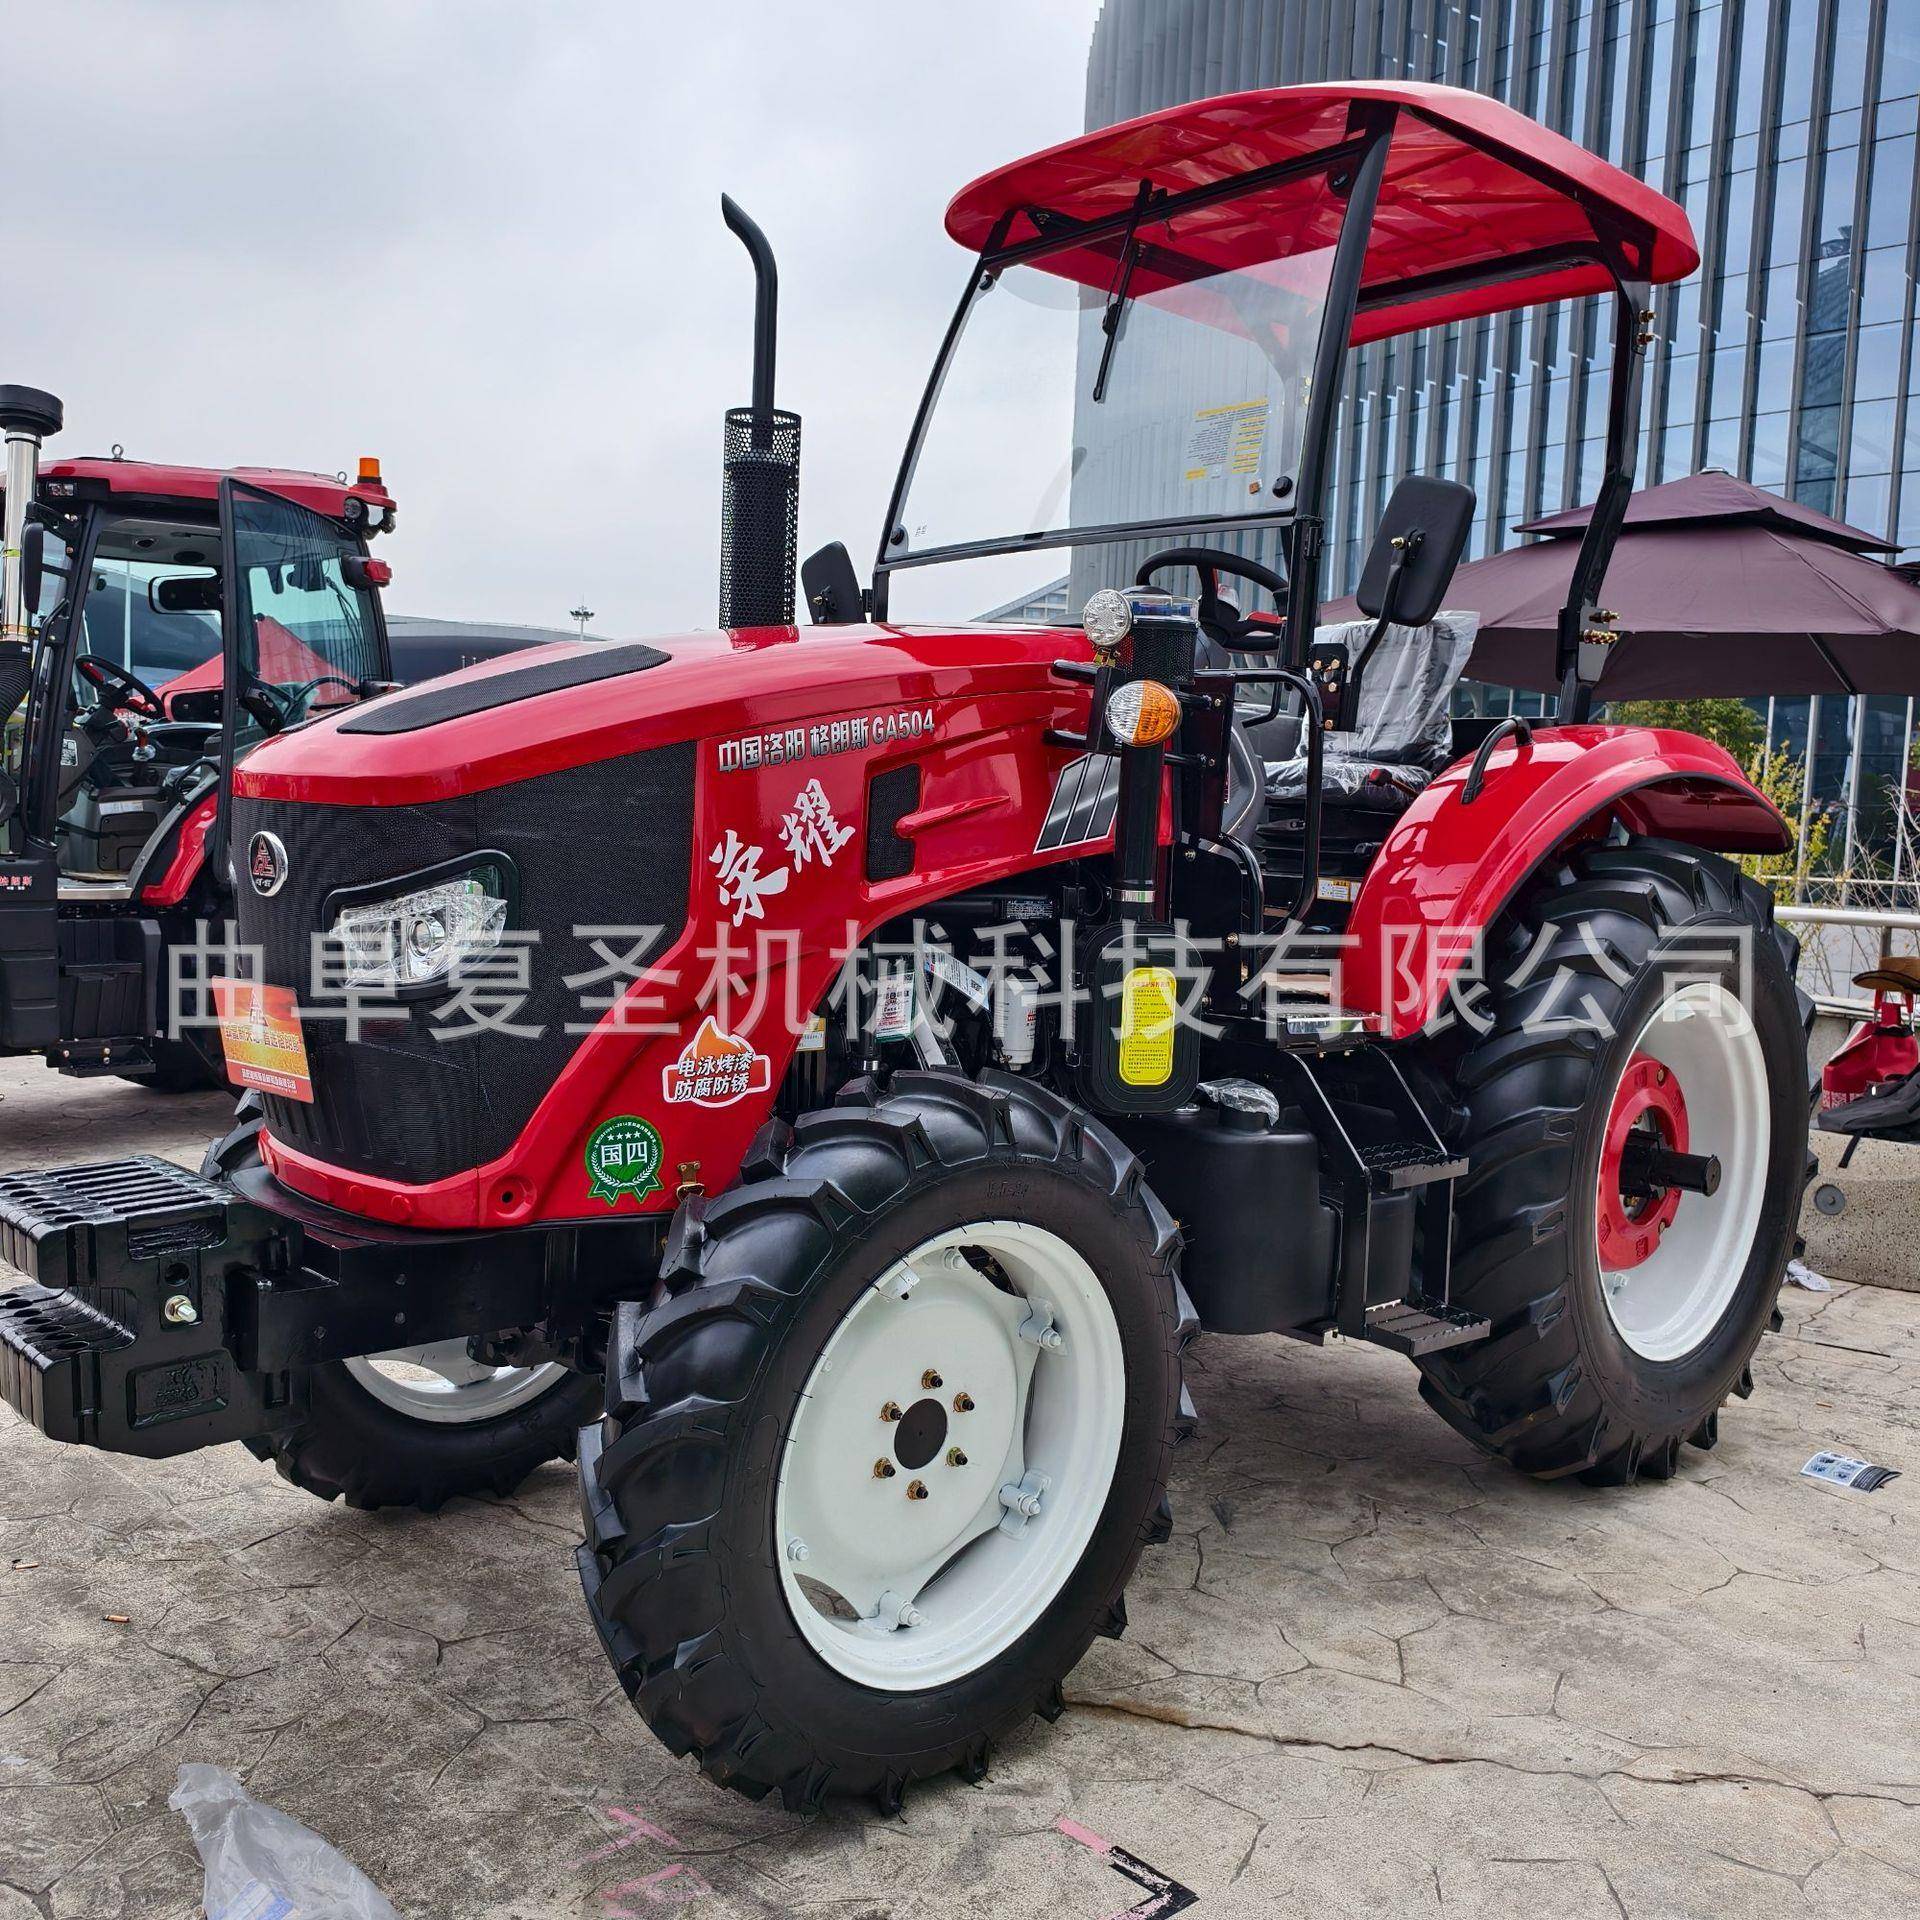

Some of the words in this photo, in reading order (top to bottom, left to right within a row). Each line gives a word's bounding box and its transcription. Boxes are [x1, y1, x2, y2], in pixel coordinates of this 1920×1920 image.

[718, 729, 806, 773] 中国洛阳
[809, 717, 869, 757] 格朗斯
[872, 708, 935, 745] GA504
[678, 1051, 754, 1078] 电泳烤漆
[674, 1073, 751, 1101] 防腐防锈
[601, 1141, 648, 1168] 国四
